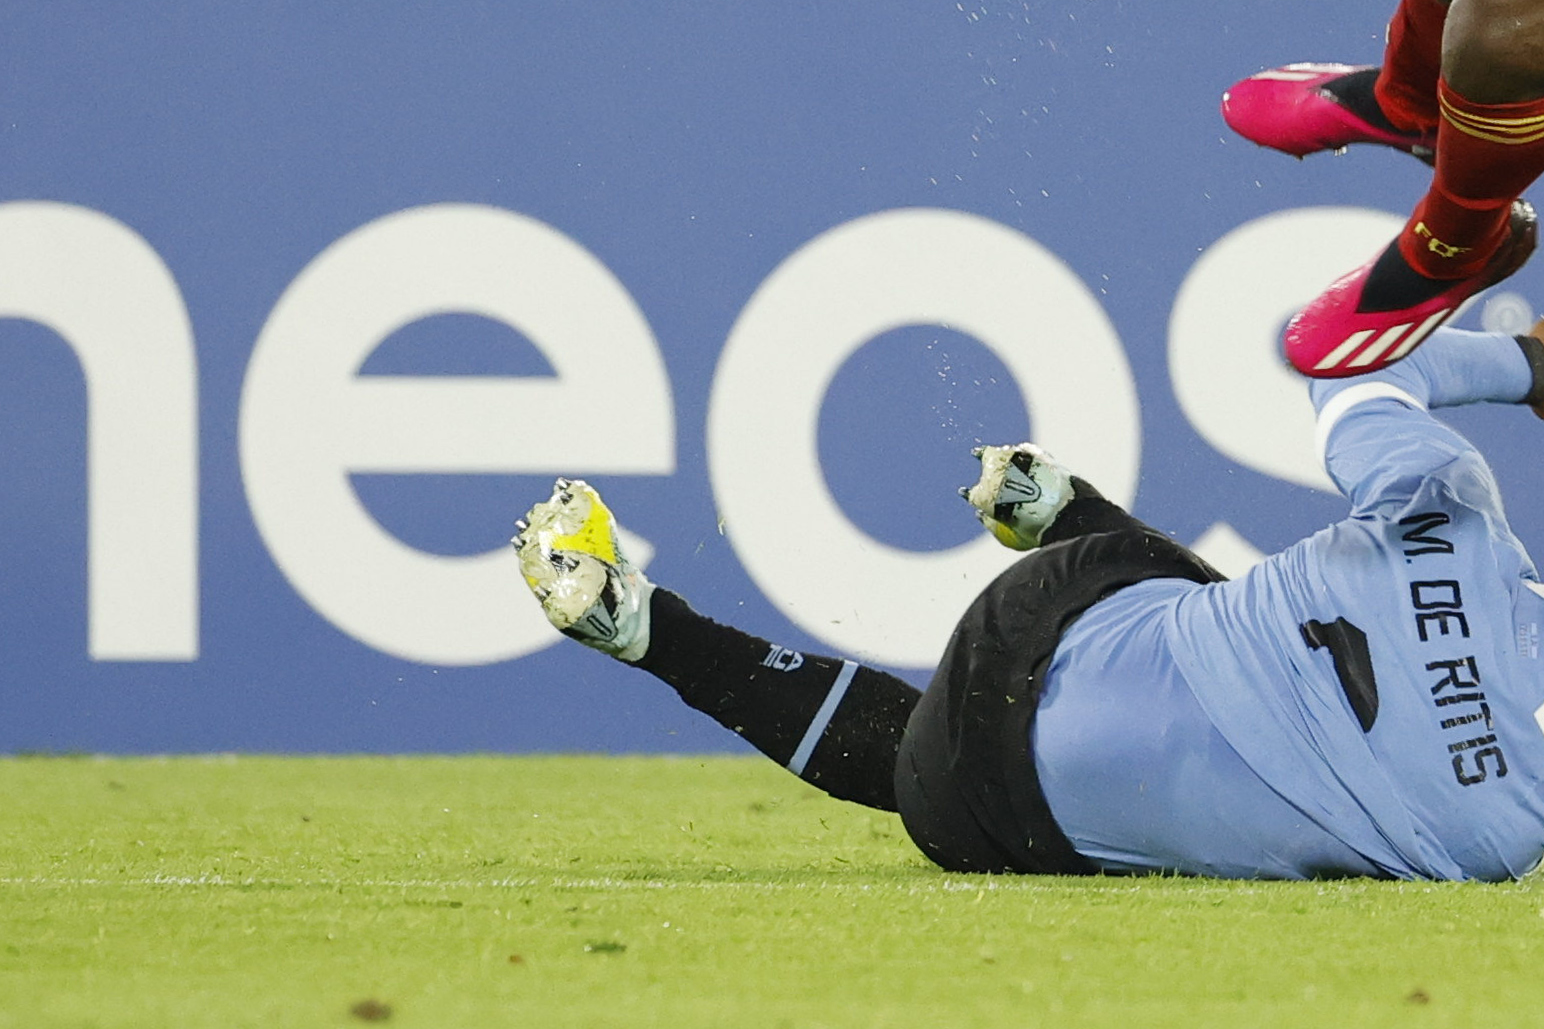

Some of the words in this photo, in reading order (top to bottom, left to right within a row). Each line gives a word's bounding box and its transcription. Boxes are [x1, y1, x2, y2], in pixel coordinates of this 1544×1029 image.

[1399, 511, 1454, 564] M.
[1410, 579, 1470, 642] DE
[1425, 656, 1509, 786] RITIS
